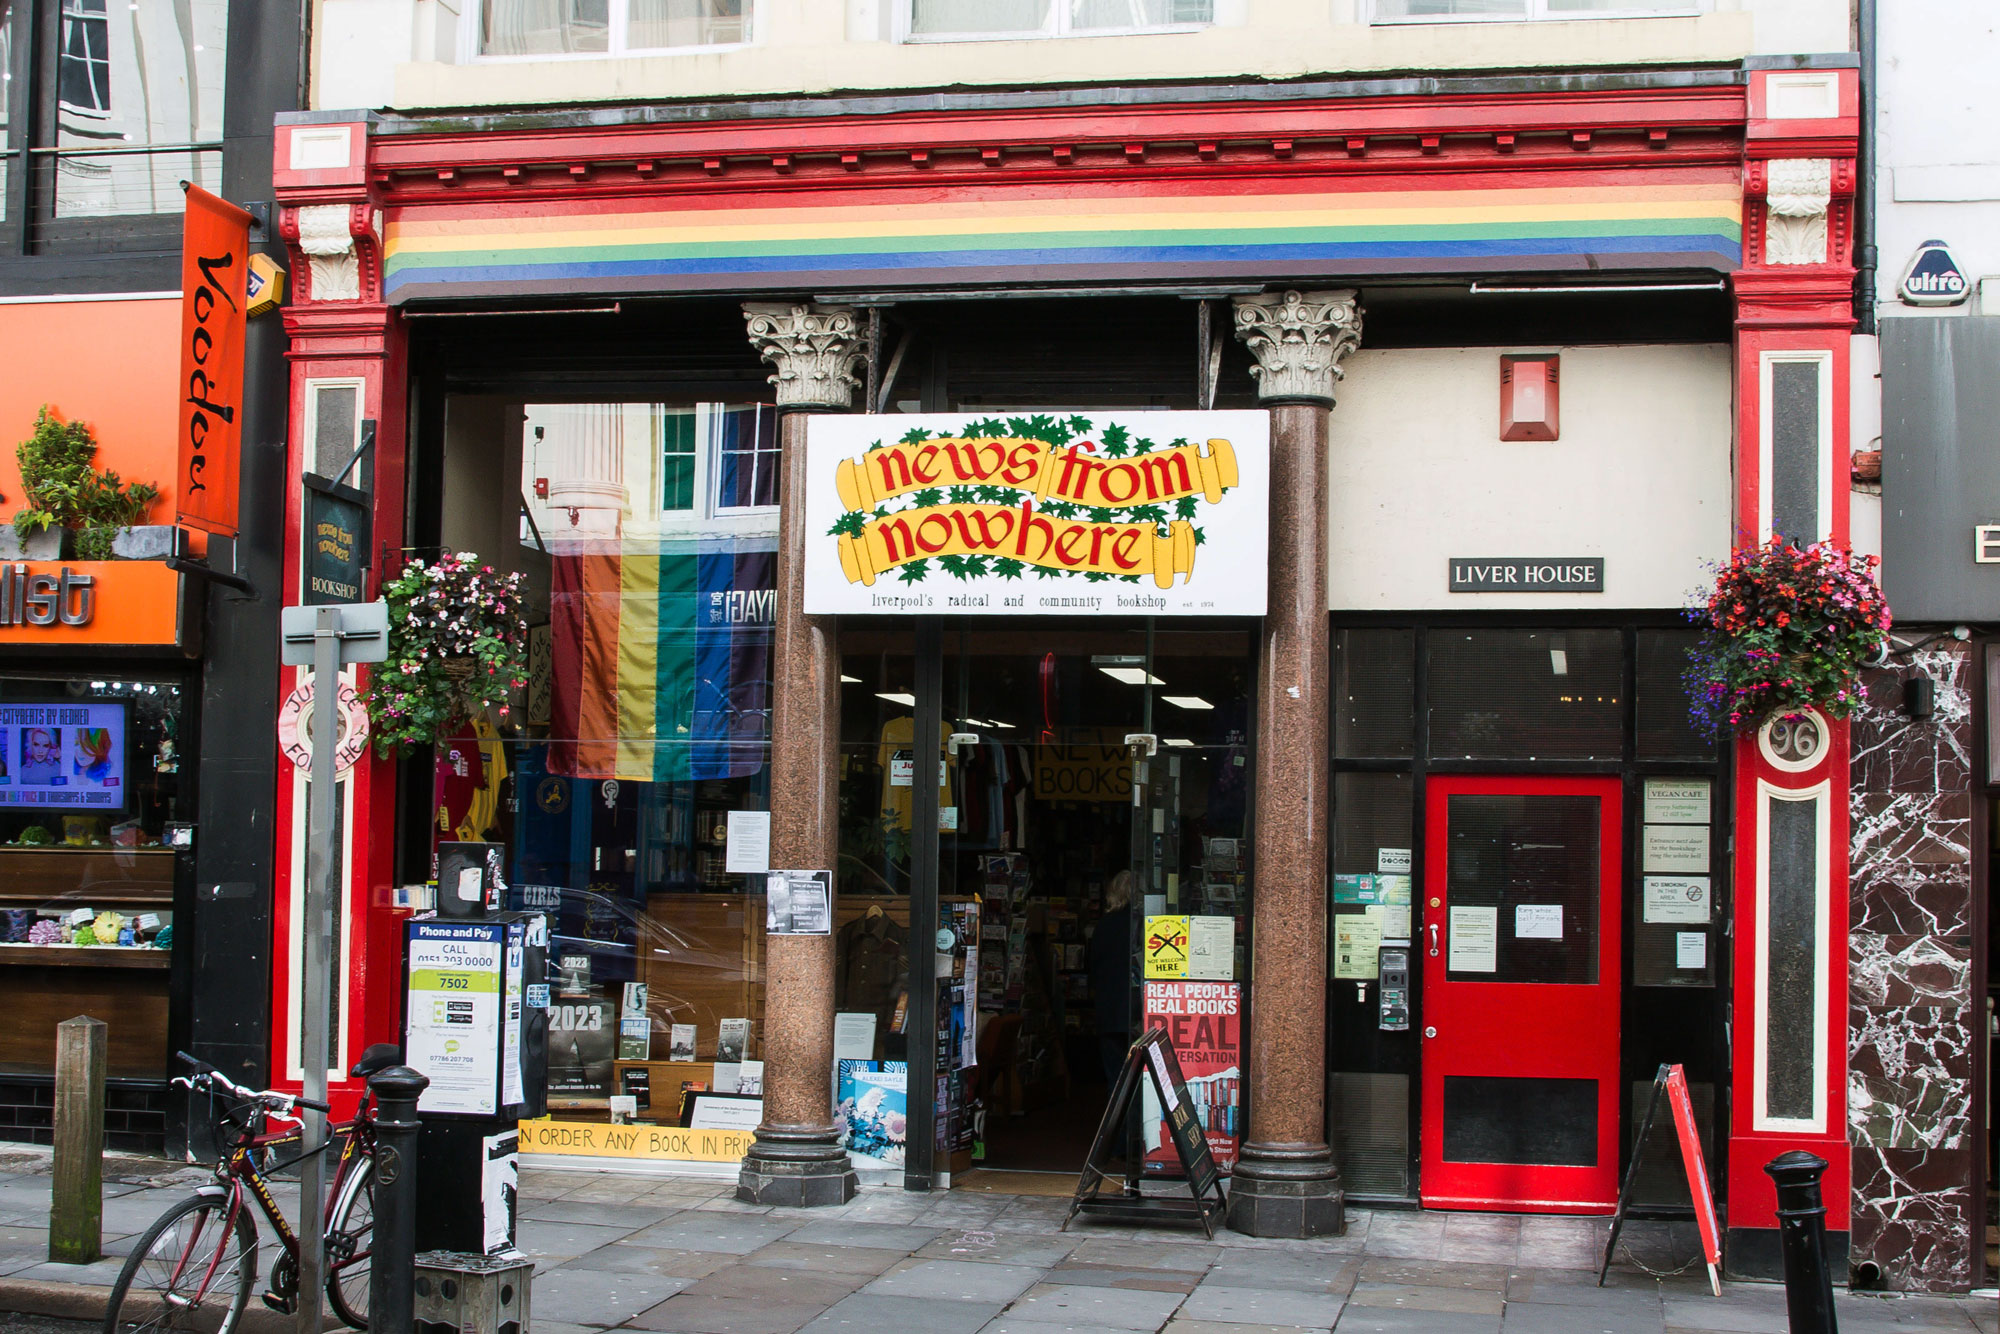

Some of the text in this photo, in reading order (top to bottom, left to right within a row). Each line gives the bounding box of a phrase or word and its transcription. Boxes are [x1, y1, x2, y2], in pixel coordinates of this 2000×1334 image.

[1908, 271, 1963, 292] ultra
[877, 441, 1192, 503] news from
[878, 500, 1142, 569] nowhere
[1456, 566, 1596, 583] LIVER HOUSE
[312, 576, 358, 599] BOOKSHOP
[872, 594, 933, 610] liverpool's
[948, 594, 989, 607] radical
[1004, 594, 1024, 607] and
[1040, 595, 1102, 611] community
[1117, 594, 1167, 611] bookshop
[1772, 721, 1816, 756] 96
[1040, 766, 1132, 794] BOOKS
[524, 887, 561, 906] GIRLS
[420, 926, 451, 937] Phone
[453, 928, 473, 937] and
[474, 928, 493, 940] Pay
[443, 945, 468, 954] CALL
[465, 957, 493, 967] 0000
[564, 957, 588, 968] 2023
[1156, 963, 1179, 972] HERE
[440, 978, 468, 989] 7502
[1148, 984, 1238, 999] REAL PEOPLE
[1147, 999, 1238, 1015] REAL BOOKS
[549, 1006, 602, 1031] 2023
[539, 1128, 596, 1148] ORDER
[605, 1131, 639, 1151] ANY
[649, 1134, 693, 1155] BOOK
[703, 1136, 717, 1155] IN
[1206, 1138, 1219, 1146] ight
